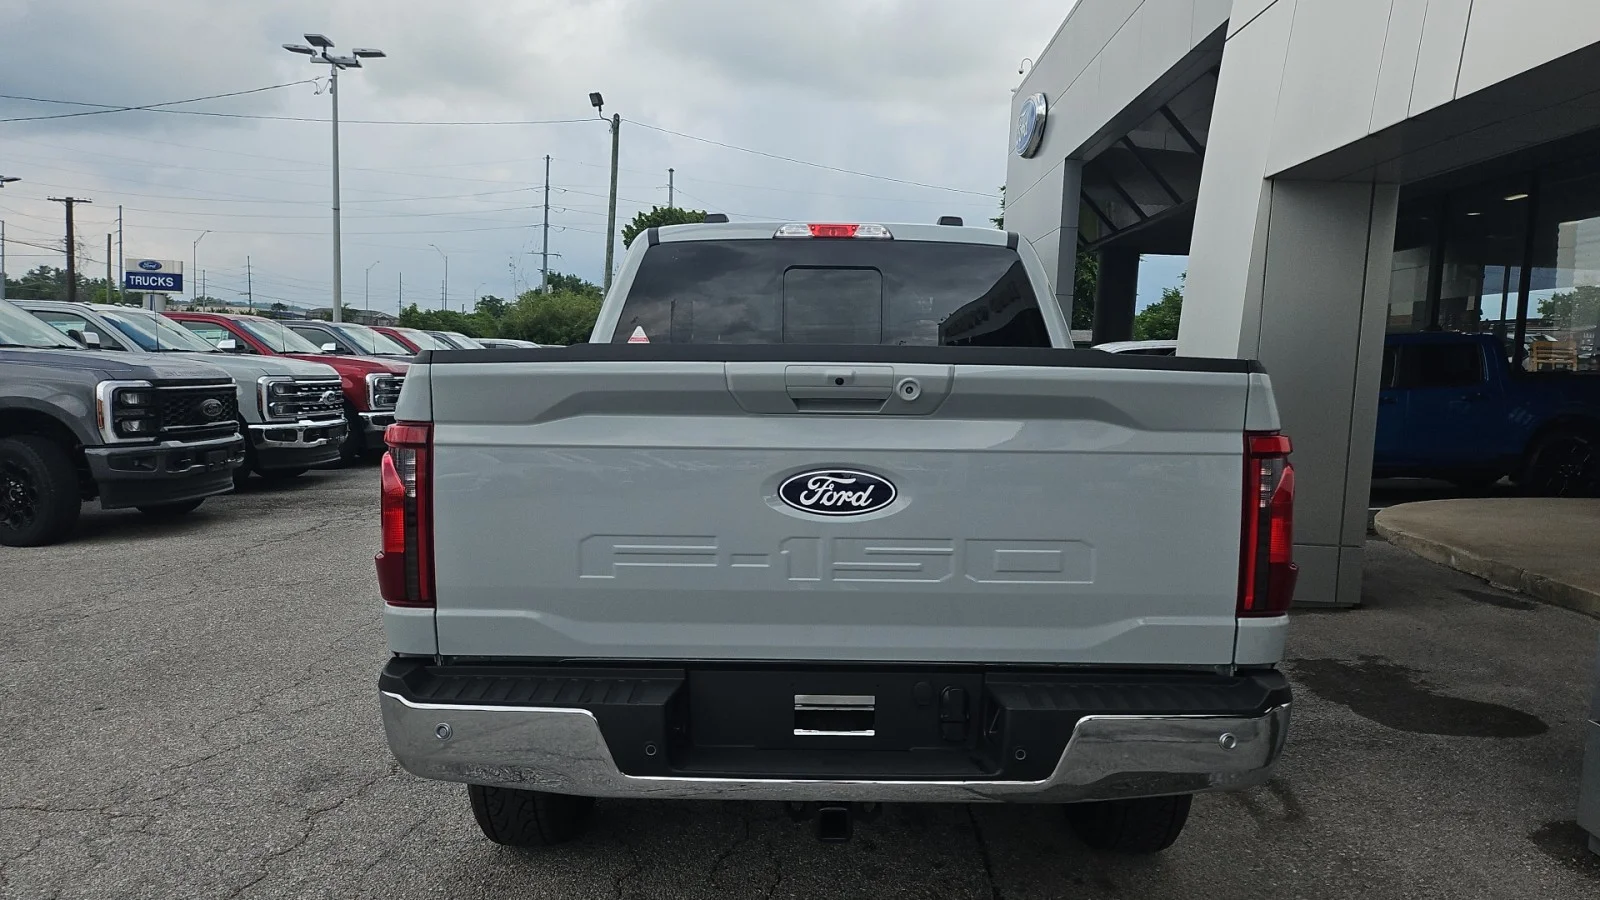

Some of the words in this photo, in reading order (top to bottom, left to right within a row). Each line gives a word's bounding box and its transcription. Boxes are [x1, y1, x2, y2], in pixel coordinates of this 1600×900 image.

[129, 275, 174, 287] TRUCKS
[800, 476, 875, 507] Ford
[578, 534, 1096, 584] F-150
